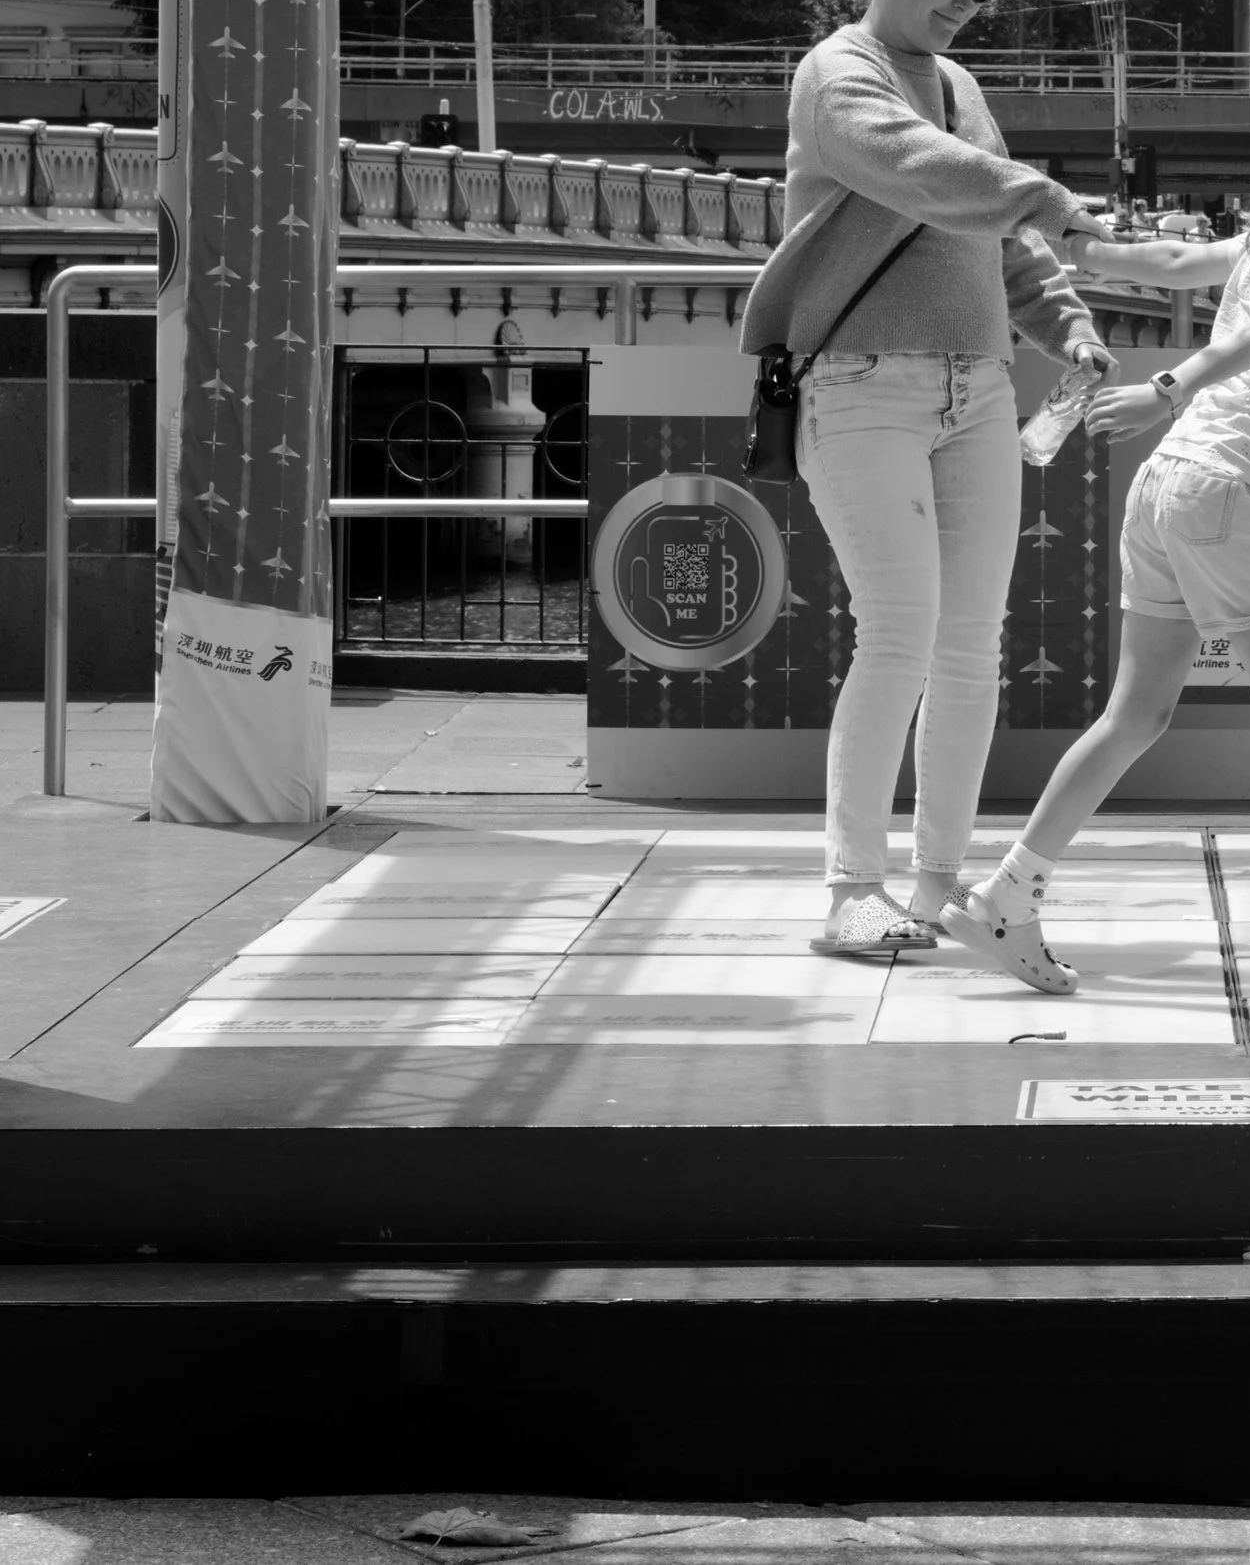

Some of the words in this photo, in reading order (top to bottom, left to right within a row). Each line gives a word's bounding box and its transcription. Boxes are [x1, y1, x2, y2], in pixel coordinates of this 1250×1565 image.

[666, 593, 707, 604] SCAN
[675, 608, 698, 619] ME
[177, 632, 254, 665] 深圳航空
[215, 660, 252, 676] Airlines
[1065, 1084, 1243, 1092] TAKE
